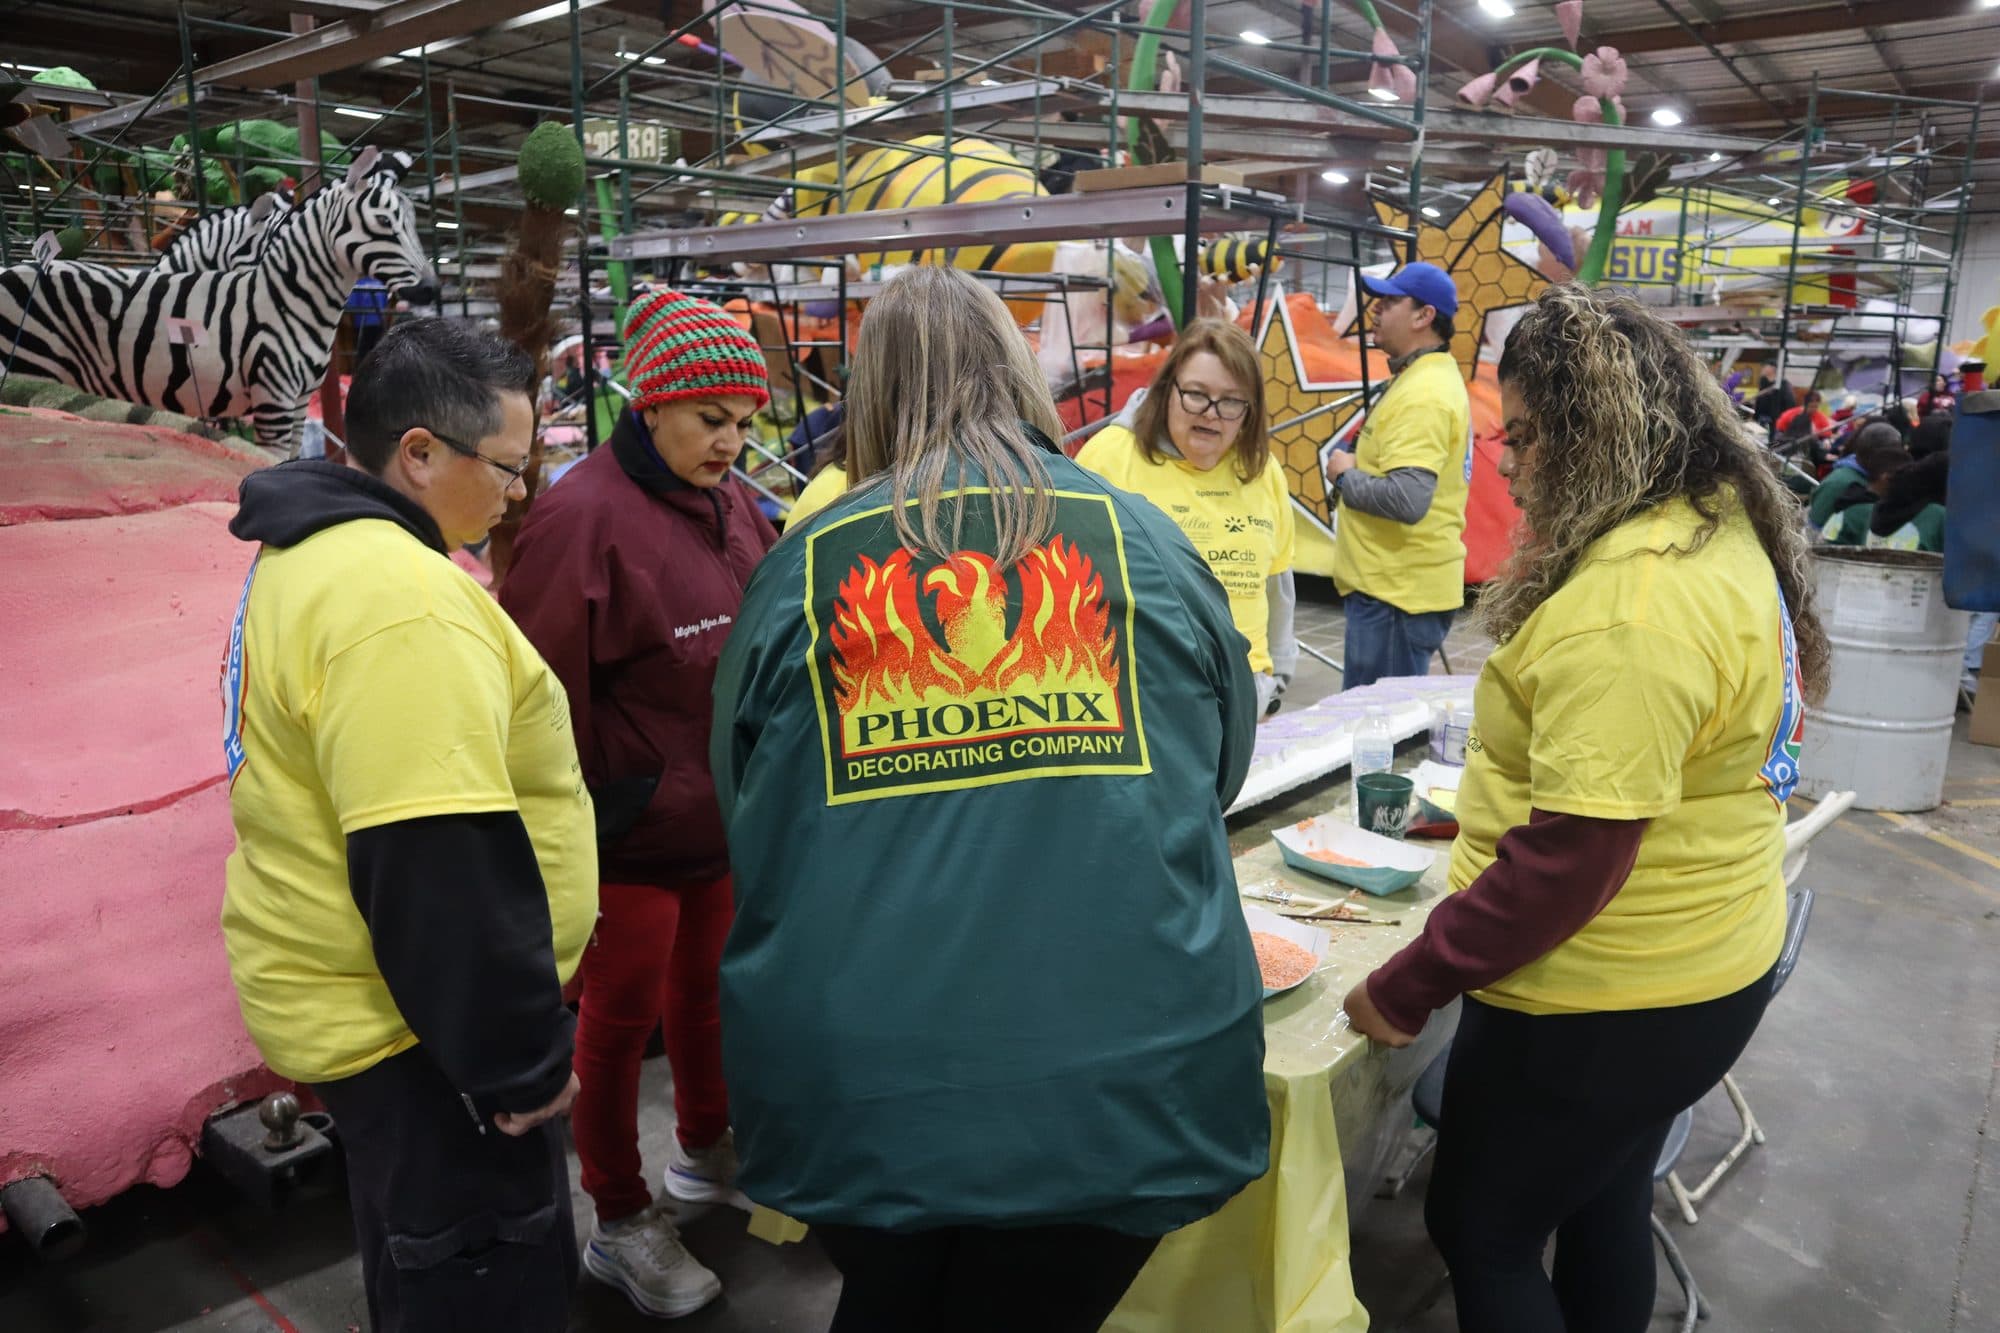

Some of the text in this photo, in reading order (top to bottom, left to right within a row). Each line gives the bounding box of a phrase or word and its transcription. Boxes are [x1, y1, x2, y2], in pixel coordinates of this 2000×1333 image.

[1208, 549, 1256, 562] DACdb
[856, 692, 1110, 747] PHOENIX
[847, 735, 1125, 780] DECORATING COMPANY
